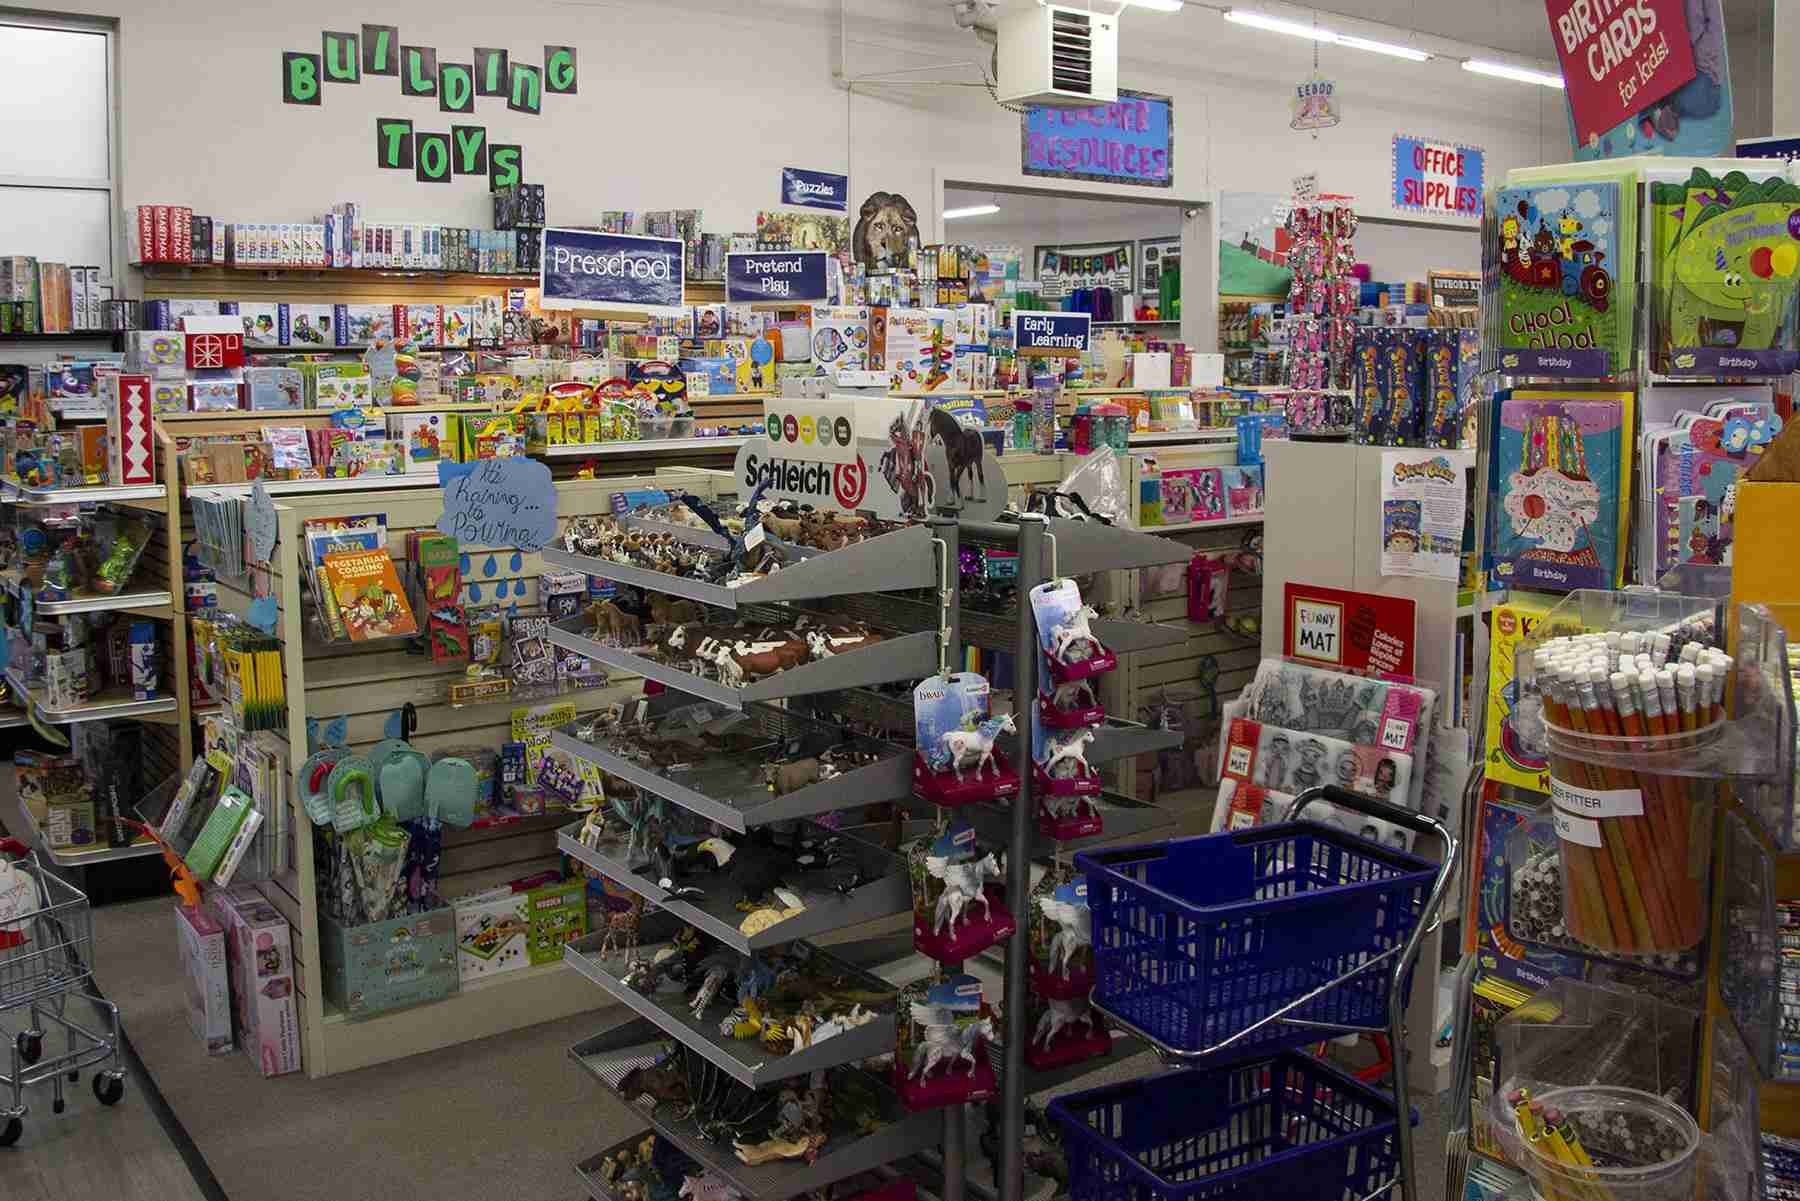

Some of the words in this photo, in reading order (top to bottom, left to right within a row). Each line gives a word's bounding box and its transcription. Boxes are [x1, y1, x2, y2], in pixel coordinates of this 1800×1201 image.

[1588, 0, 1656, 81] CARDS
[1618, 76, 1637, 108] for
[1636, 32, 1669, 86] kids!
[382, 124, 519, 187] TOYS
[1028, 131, 1167, 177] RESOURCES
[1413, 146, 1465, 177] OFFICE
[796, 179, 834, 196] Puzzles
[1403, 179, 1476, 210] SUPPLIES
[554, 247, 670, 280] Preschool
[745, 257, 802, 274] Pretend
[762, 277, 790, 296] Play
[1024, 317, 1055, 335] Early
[1031, 334, 1085, 349] Learning
[1538, 356, 1572, 369] Birthday
[1719, 356, 1758, 370] Birthday
[746, 454, 831, 496] Schleich
[327, 554, 390, 569] VEGETARIAN
[338, 563, 385, 576] COOKING
[1533, 567, 1567, 583] Birthday
[1301, 608, 1336, 628] FUNNY
[1300, 629, 1336, 652] MAT
[1564, 791, 1601, 808] FITTER
[1516, 967, 1550, 988] Birthday
